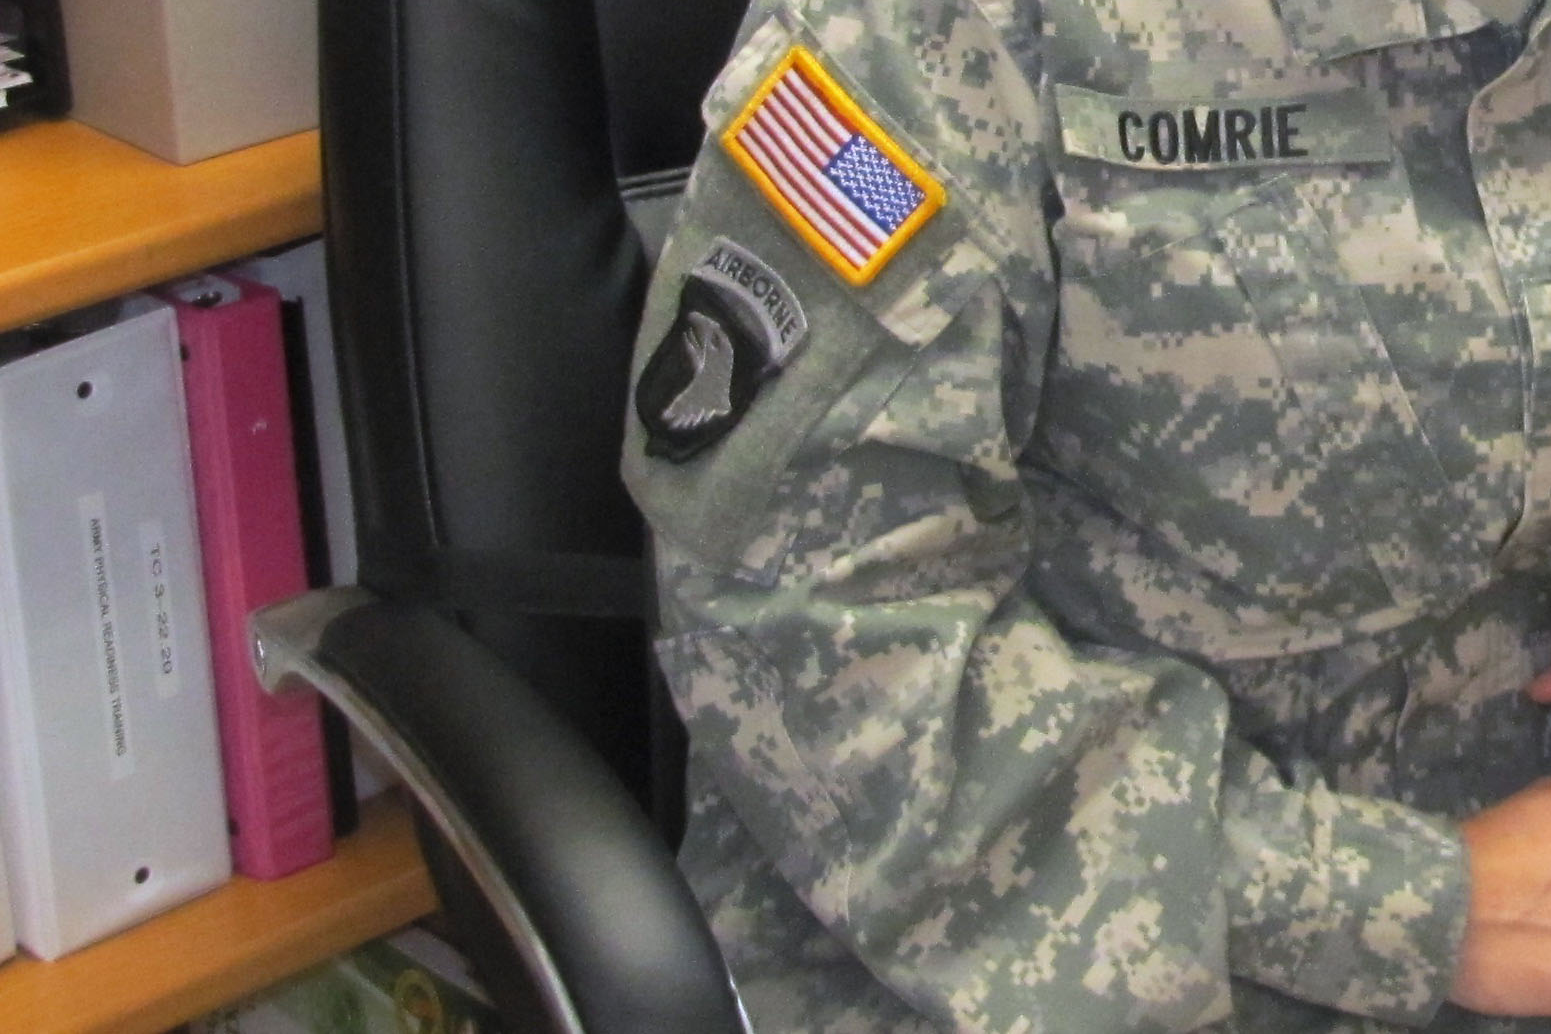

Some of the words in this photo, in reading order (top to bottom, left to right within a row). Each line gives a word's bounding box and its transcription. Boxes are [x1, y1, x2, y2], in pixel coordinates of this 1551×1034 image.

[1117, 104, 1310, 166] COMRIE
[704, 248, 798, 345] AIRBORNE
[90, 518, 103, 553] ARMY
[93, 556, 109, 618] PHYSICAL
[102, 621, 120, 695] READINESS
[111, 697, 128, 757] TRAINING
